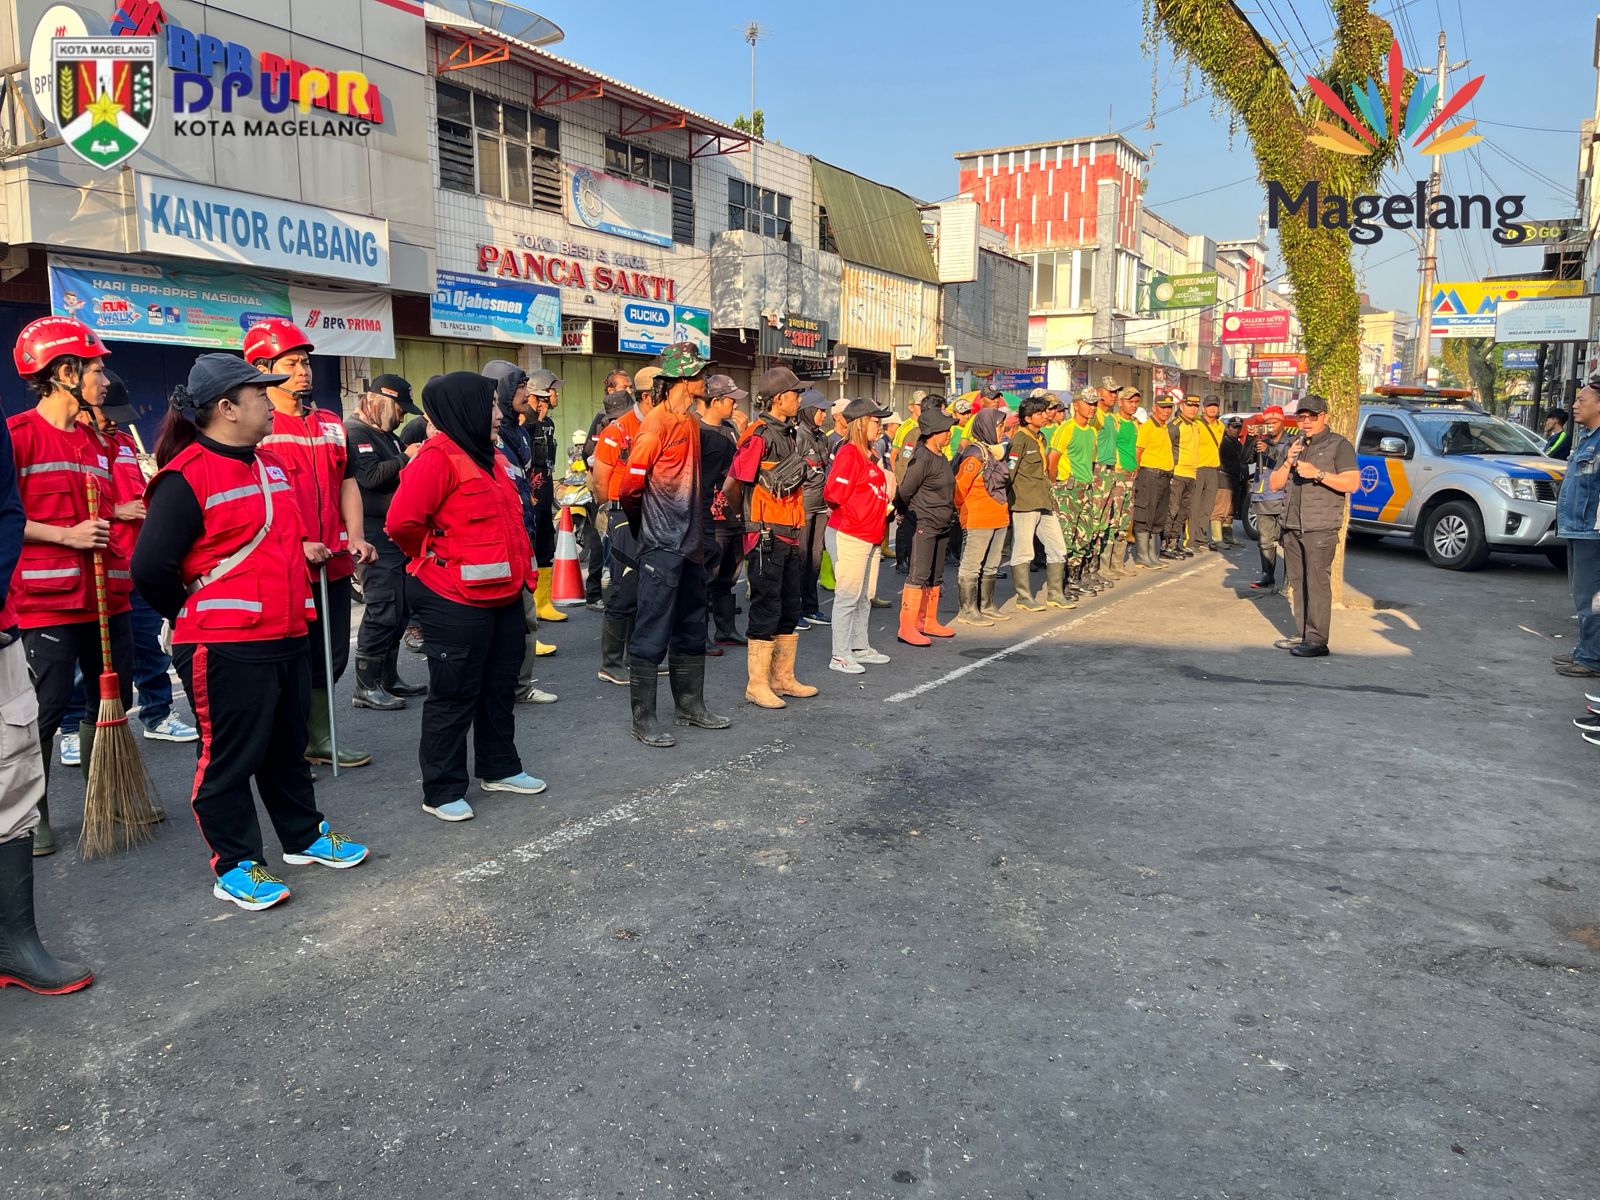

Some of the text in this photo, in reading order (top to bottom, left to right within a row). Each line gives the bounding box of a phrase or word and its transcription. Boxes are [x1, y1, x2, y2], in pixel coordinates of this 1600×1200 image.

[167, 24, 253, 78] BPR
[150, 192, 379, 268] KANTOR CABANG
[513, 232, 552, 252] TOKO
[560, 241, 591, 260] BESI
[476, 243, 676, 302] PANCA SAKTI
[92, 279, 262, 306] HARI BPR-BPRS NASIONAL
[453, 290, 523, 314] Djabesmen
[101, 300, 128, 312] FUN
[101, 312, 133, 322] WALK
[630, 308, 665, 323] RUCIKA
[323, 317, 382, 332] BPR PRIMA
[449, 322, 466, 331] PANCA
